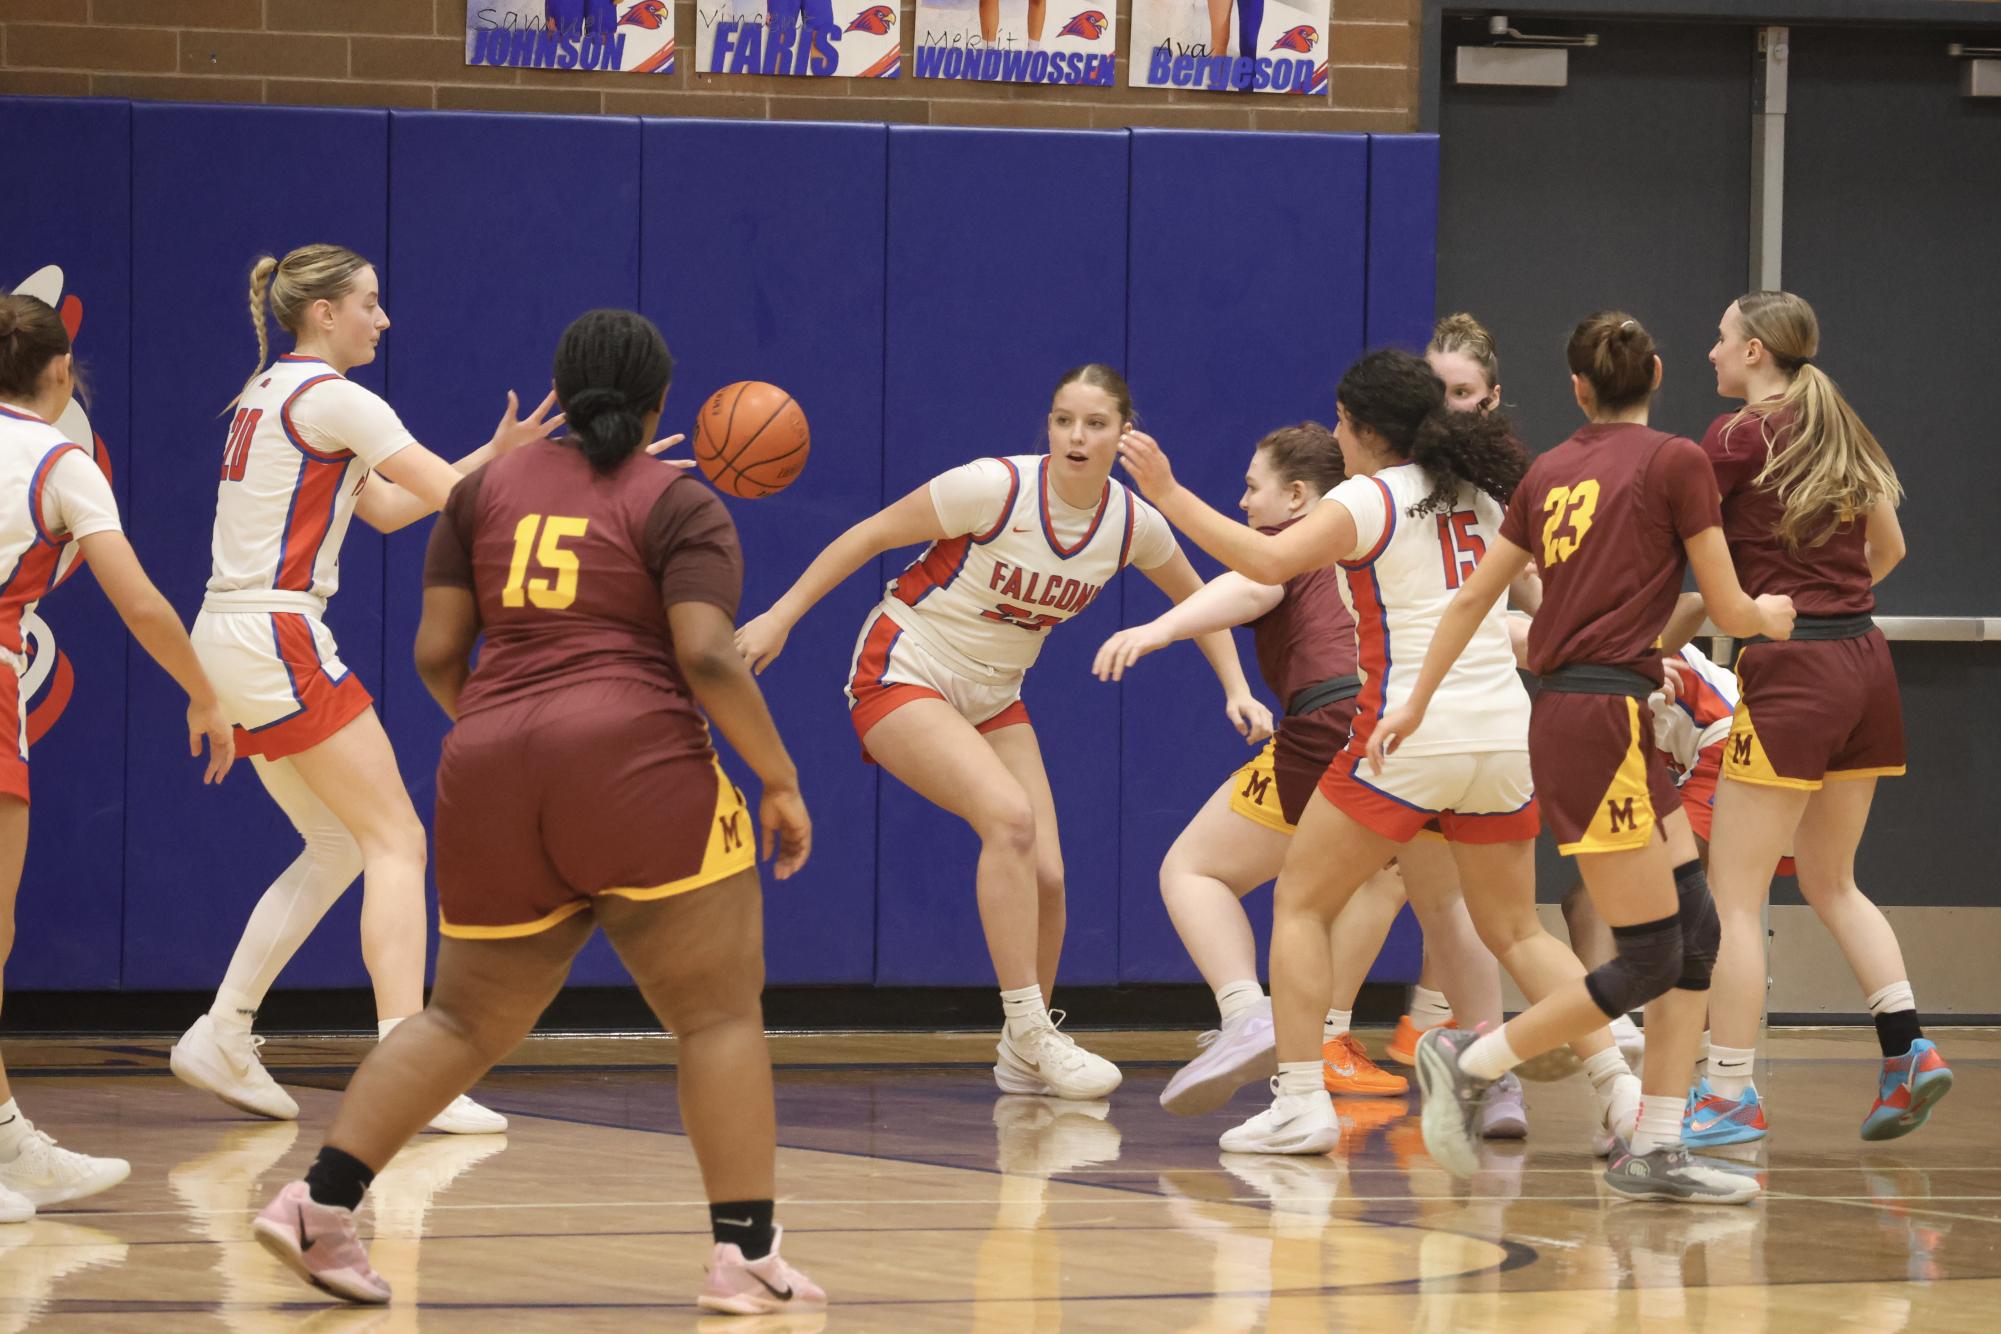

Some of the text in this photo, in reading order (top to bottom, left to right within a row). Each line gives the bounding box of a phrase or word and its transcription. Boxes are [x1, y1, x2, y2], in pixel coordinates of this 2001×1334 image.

[471, 27, 626, 70] JOHNSON
[711, 22, 843, 77] FARIS
[916, 45, 1116, 87] WONDWOSSEN
[1156, 37, 1215, 58] Ava
[1148, 46, 1315, 94] Bergeson
[221, 408, 263, 482] 20
[1542, 479, 1600, 568] 23
[502, 513, 589, 610] 15
[1436, 510, 1487, 590] 15
[1732, 733, 1753, 766] M
[1242, 770, 1272, 806] M
[718, 810, 743, 854] M
[1607, 797, 1637, 834] M
